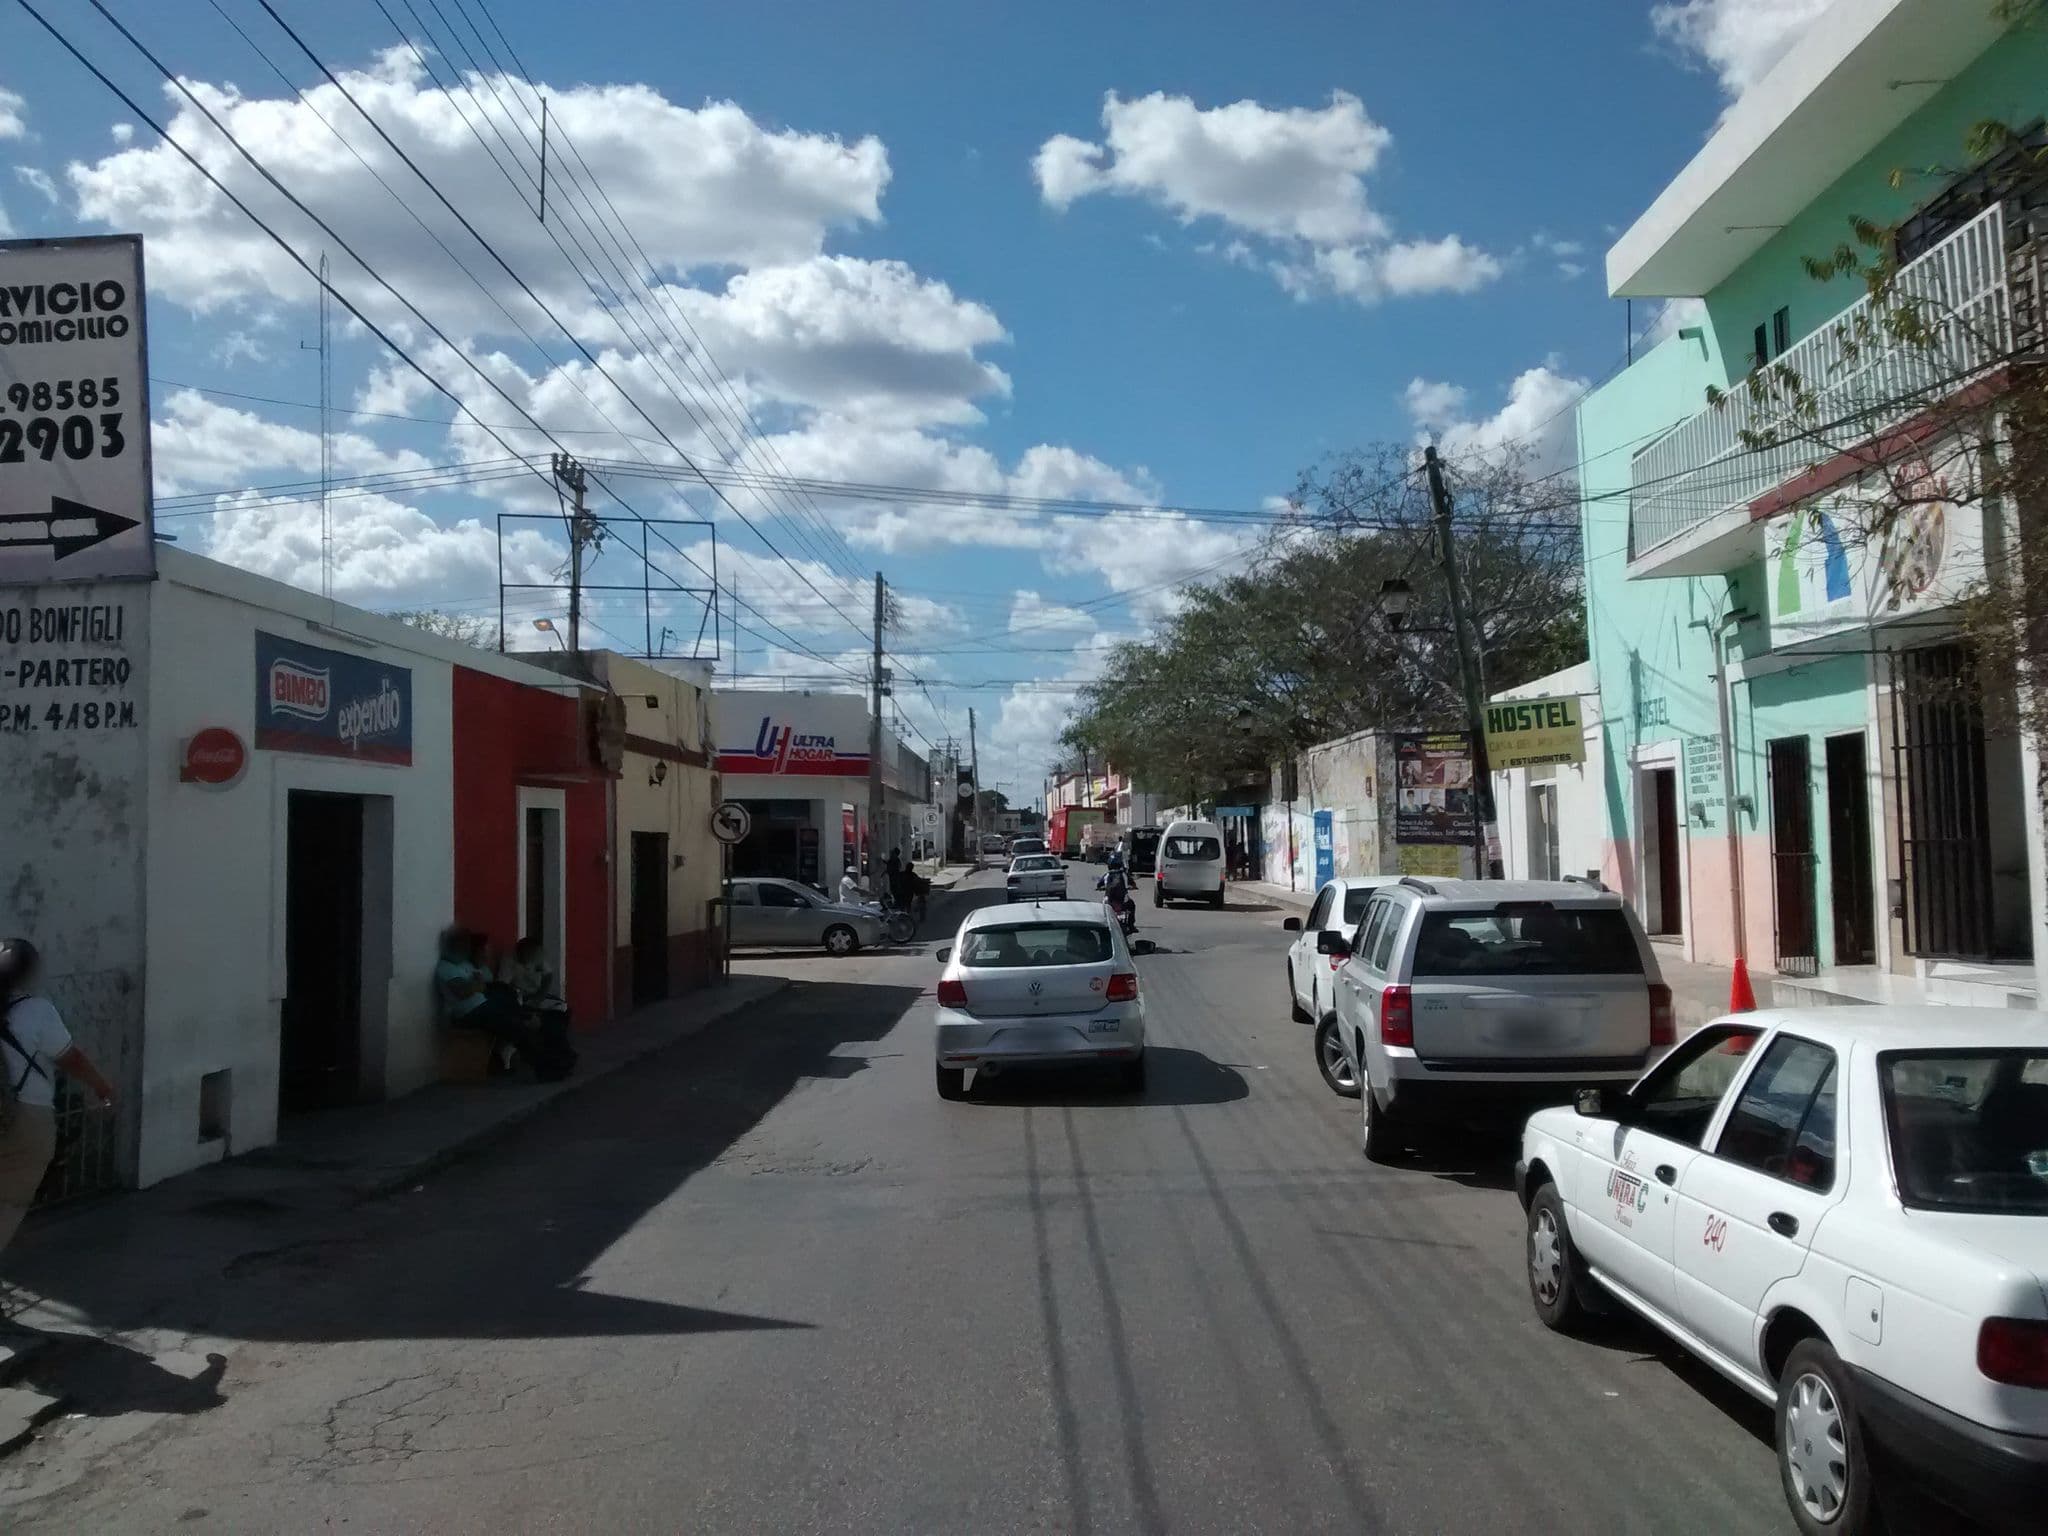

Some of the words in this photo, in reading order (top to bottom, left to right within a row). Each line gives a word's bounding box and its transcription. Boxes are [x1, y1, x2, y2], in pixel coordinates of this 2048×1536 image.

[0, 413, 125, 463] 2903
[30, 605, 123, 643] BONFIGLI
[274, 671, 327, 709] BIMBO
[338, 679, 400, 750] expendio
[1488, 702, 1576, 733] HOSTEL
[789, 748, 833, 760] HOGAR
[793, 735, 834, 747] ULTRA
[1510, 753, 1572, 766] ESTUDIANTES
[1703, 1214, 1727, 1253] 240
